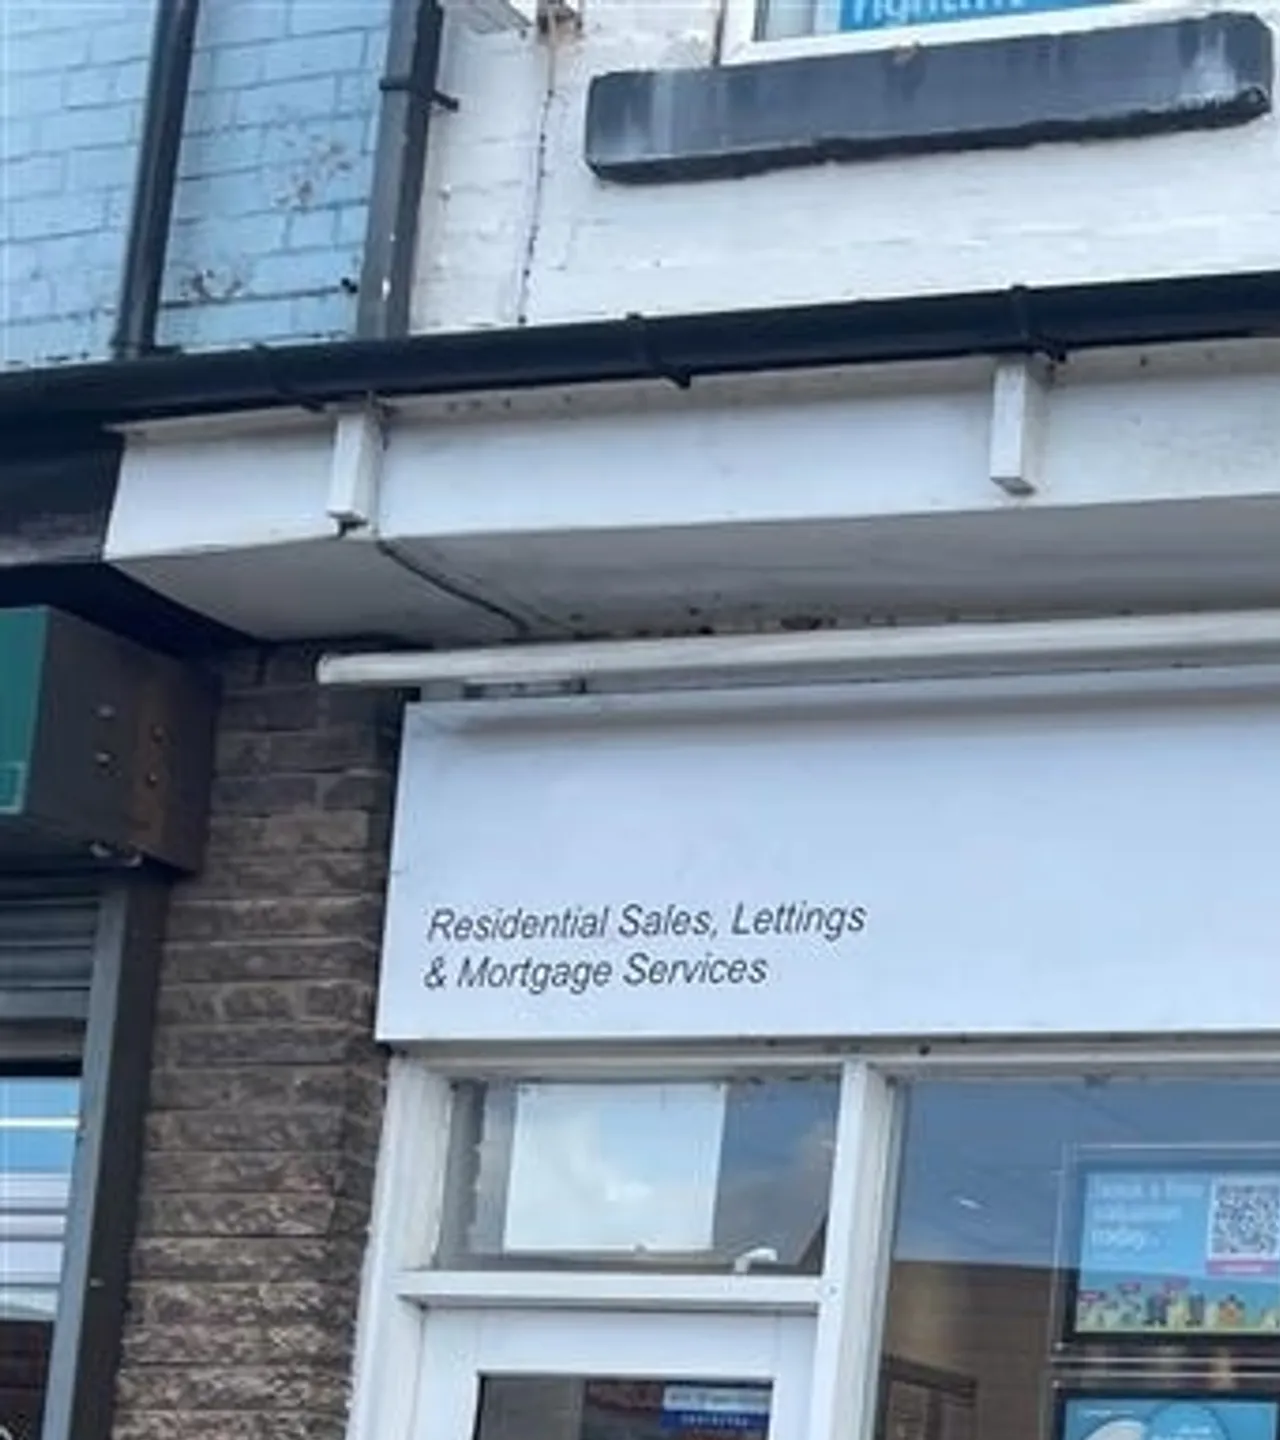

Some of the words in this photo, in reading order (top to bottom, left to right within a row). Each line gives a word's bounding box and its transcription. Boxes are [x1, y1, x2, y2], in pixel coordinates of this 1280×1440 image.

[427, 906, 610, 941] Residential
[618, 904, 718, 940] Sales,
[731, 901, 868, 942] Lettings
[424, 956, 447, 989] &
[457, 956, 613, 995] Mortgage
[622, 952, 767, 986] Services
